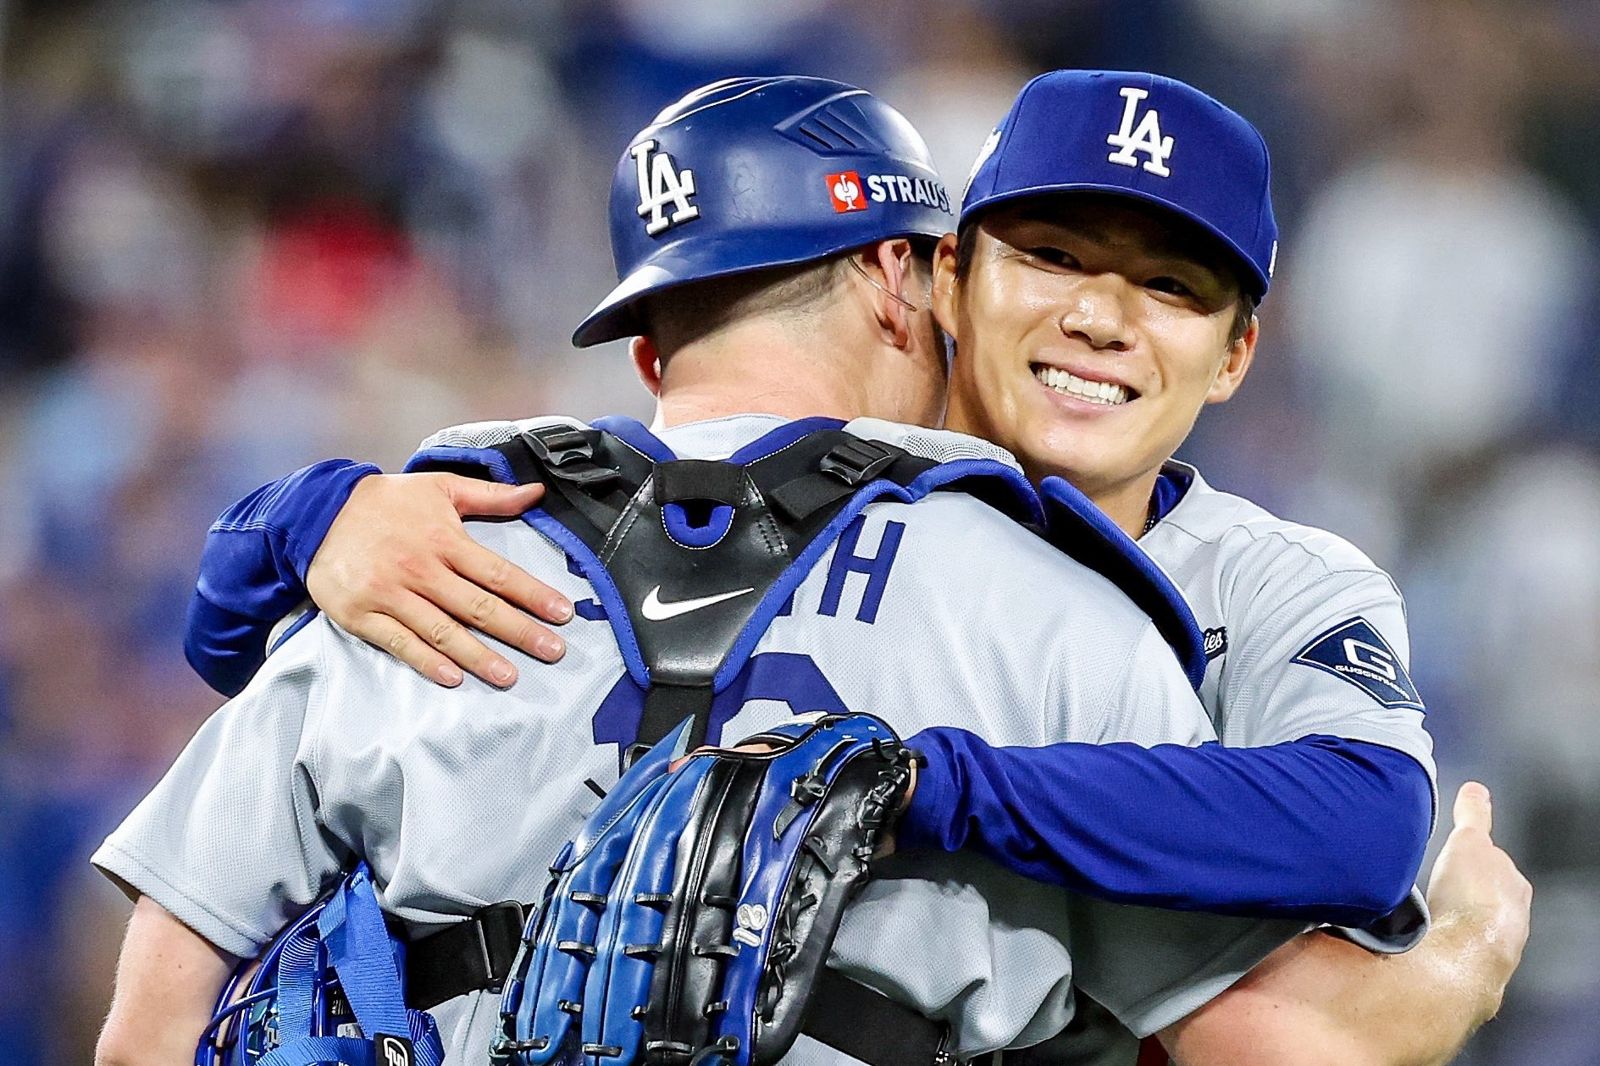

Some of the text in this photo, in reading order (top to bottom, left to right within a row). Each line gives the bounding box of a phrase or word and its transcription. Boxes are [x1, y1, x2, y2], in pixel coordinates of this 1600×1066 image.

[1107, 87, 1174, 177] LA
[631, 140, 699, 235] LA
[1203, 631, 1224, 654] ies
